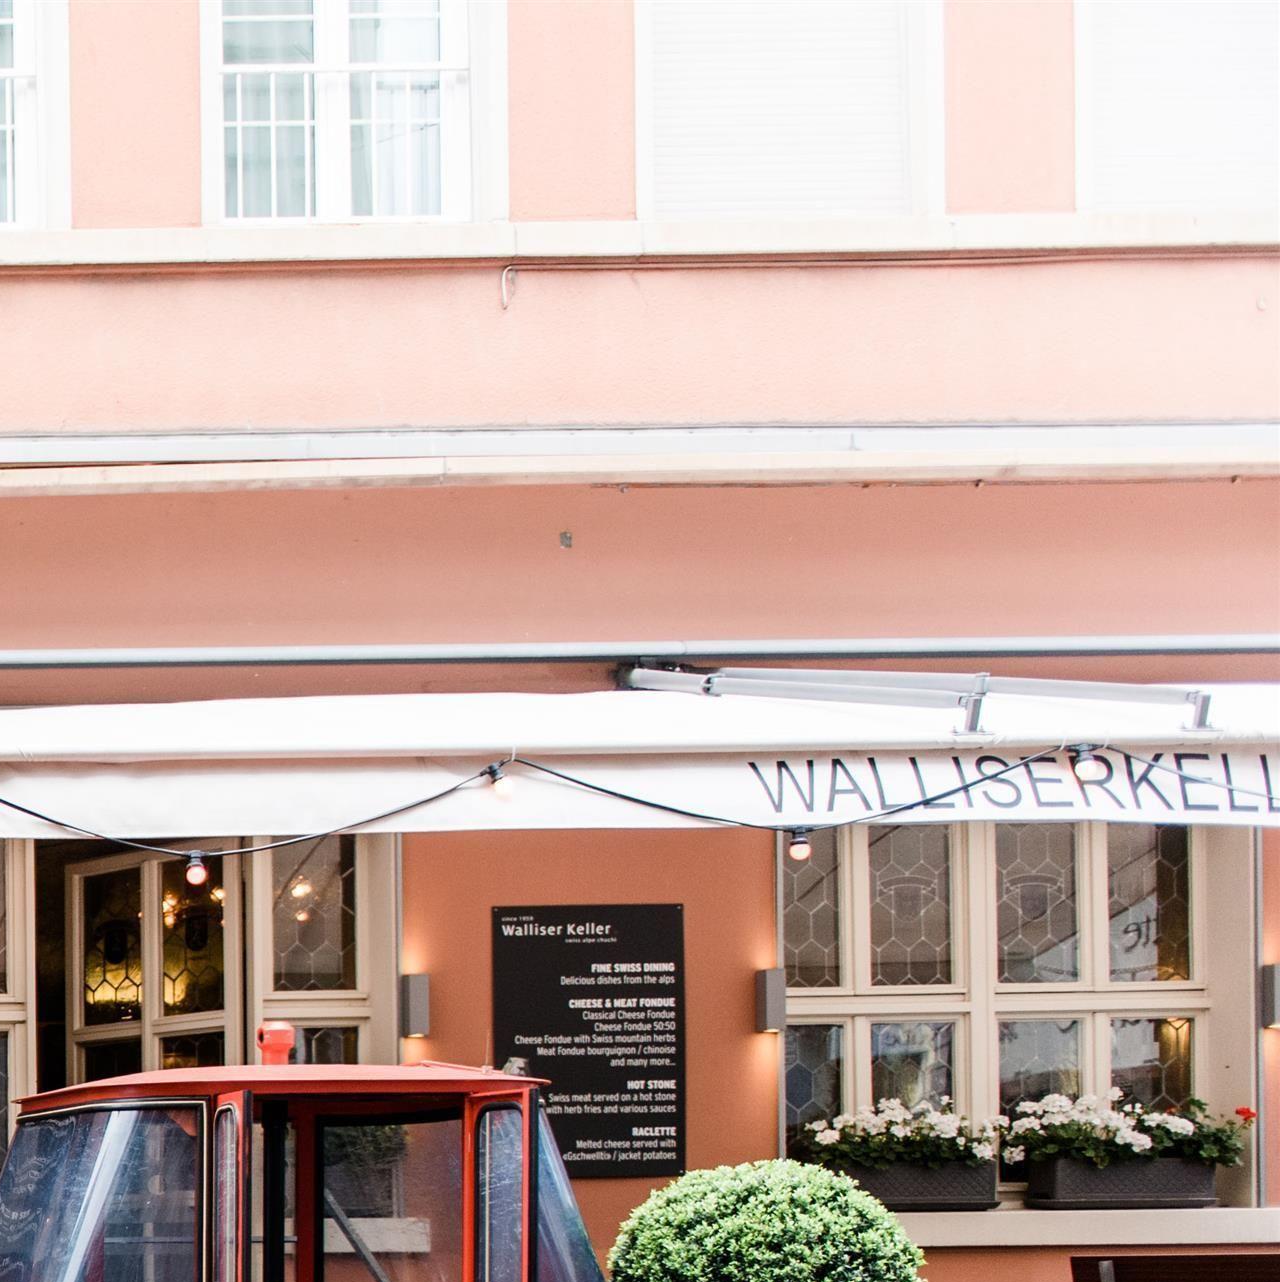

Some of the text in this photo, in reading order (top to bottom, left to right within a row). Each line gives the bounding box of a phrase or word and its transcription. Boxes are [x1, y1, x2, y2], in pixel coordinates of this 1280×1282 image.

[501, 923, 611, 936] Walliser Keller
[591, 962, 675, 973] FINE SWISS DINING
[560, 974, 675, 985] Delicious dishes from the alps
[568, 998, 602, 1008] CHEESE
[614, 998, 637, 1008] MEAT
[640, 997, 676, 1007] FONDUE
[582, 1009, 676, 1020] Classical Cheese Fondue
[594, 1021, 676, 1032] Cheese Fondue 50:50
[514, 1033, 676, 1044] Cheese Fondue with Swiss mountain herbs
[537, 1047, 555, 1056] Meat
[558, 1046, 585, 1055] Fondue
[587, 1046, 636, 1056] bourguignon
[643, 1045, 676, 1054] chinoise
[610, 1057, 625, 1067] and
[627, 1058, 648, 1068] many
[627, 1080, 676, 1090] HOT STONE
[548, 1093, 570, 1102] Swiss
[572, 1093, 591, 1102] meat
[593, 1093, 619, 1102] served
[621, 1094, 631, 1102] on
[640, 1092, 652, 1101] hot
[655, 1092, 676, 1101] stone
[546, 1104, 676, 1114] with herb fries and various sauces
[632, 1126, 676, 1136] RACLETTE
[576, 1139, 676, 1149] Melted cheese served with
[619, 1151, 641, 1161] jacket
[643, 1151, 676, 1161] potatoes
